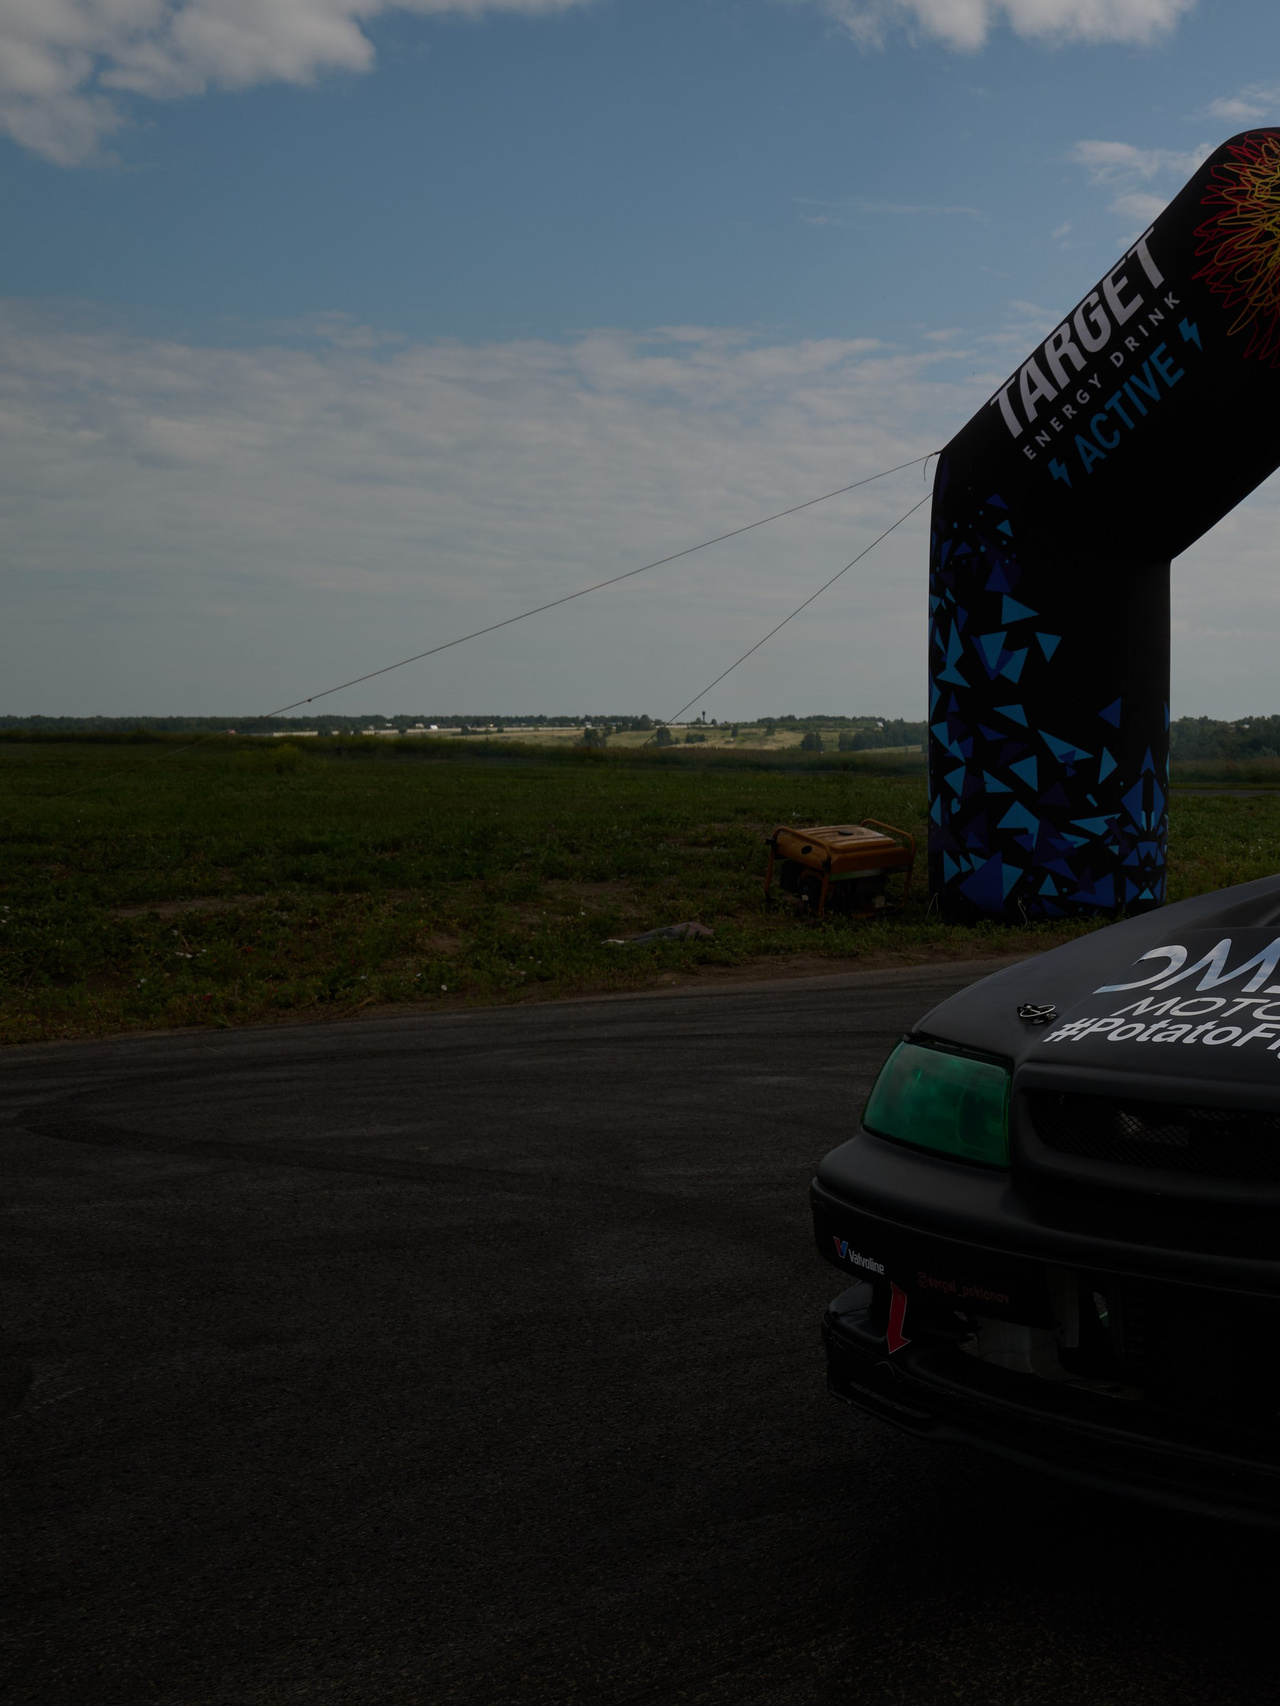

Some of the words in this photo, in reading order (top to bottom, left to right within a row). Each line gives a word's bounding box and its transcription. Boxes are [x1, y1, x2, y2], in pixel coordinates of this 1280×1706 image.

[990, 227, 1168, 439] TARGET
[1022, 373, 1103, 461] ENERGY
[1110, 291, 1182, 367] DRINK
[1072, 341, 1186, 475] ACTIVE
[848, 1248, 885, 1276] Valvoline
